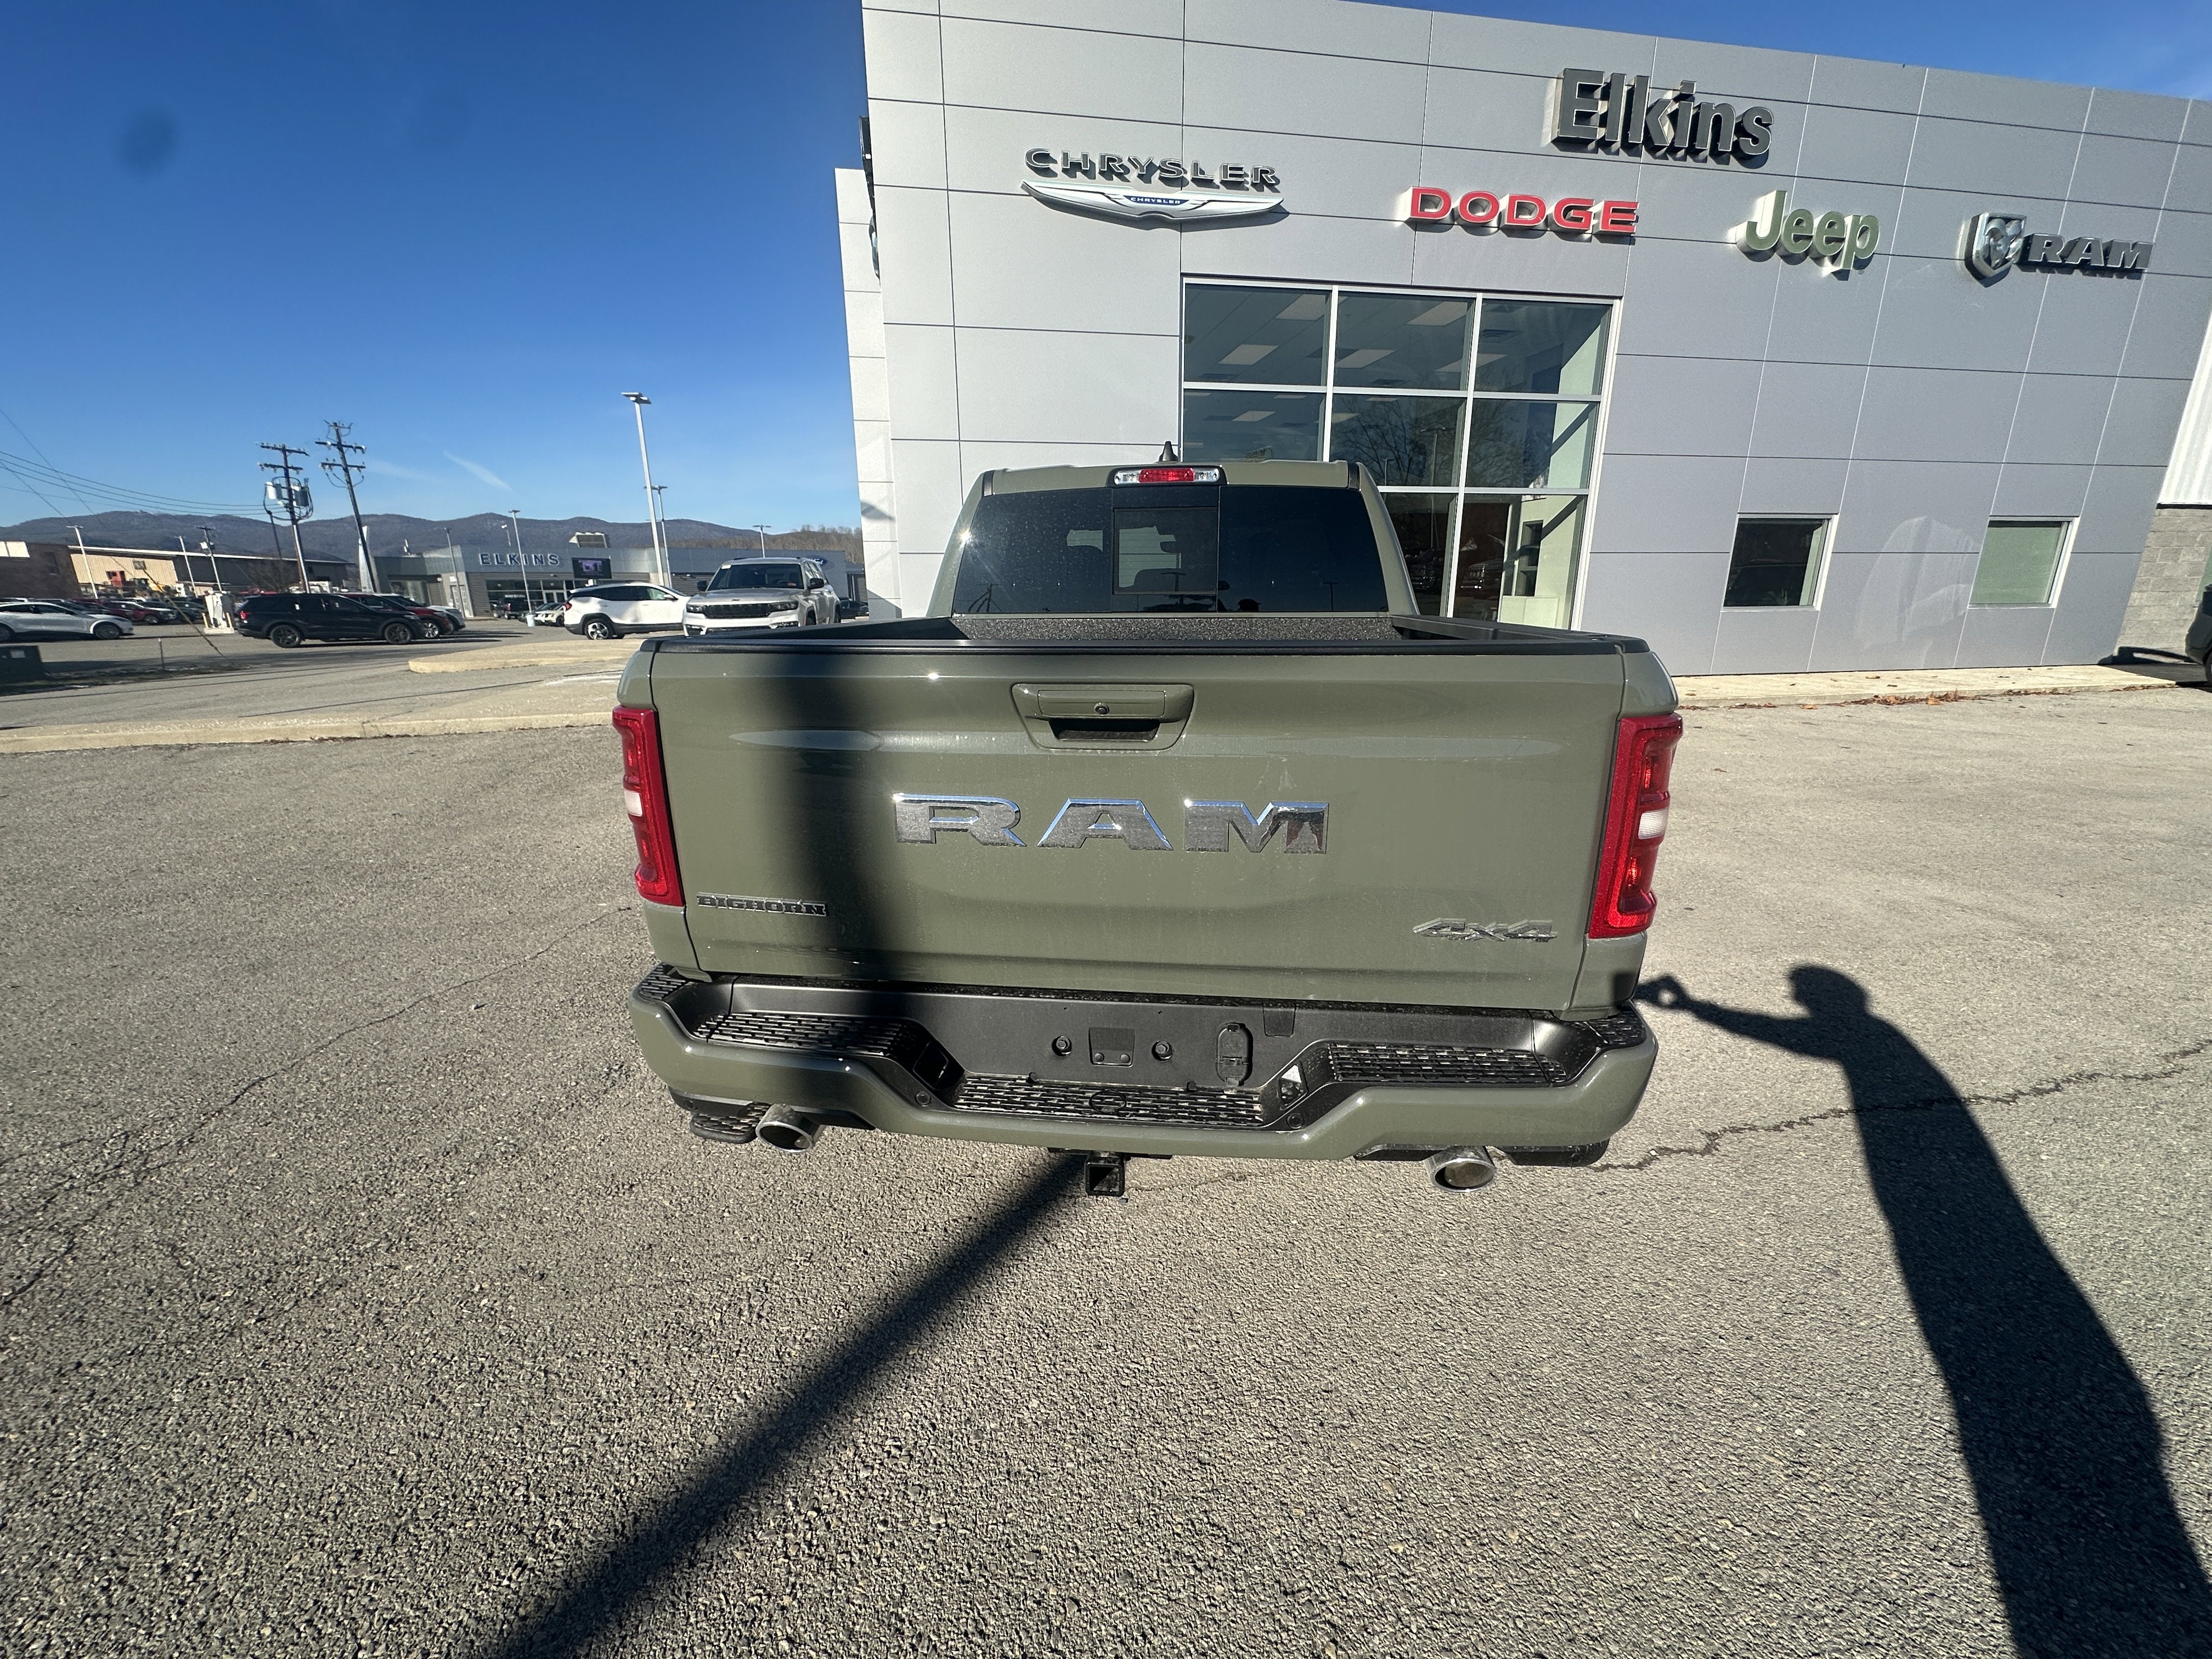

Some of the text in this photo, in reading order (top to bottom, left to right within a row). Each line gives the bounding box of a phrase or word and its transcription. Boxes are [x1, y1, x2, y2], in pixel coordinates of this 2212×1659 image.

[1554, 68, 1774, 156] Elkins
[1025, 148, 1278, 184] CHRYSLER
[1410, 187, 1639, 234] DODGE
[1745, 190, 1880, 270] Jeep
[2028, 233, 2155, 269] RAM
[479, 553, 560, 566] ELKINS
[893, 793, 1328, 854] RAM
